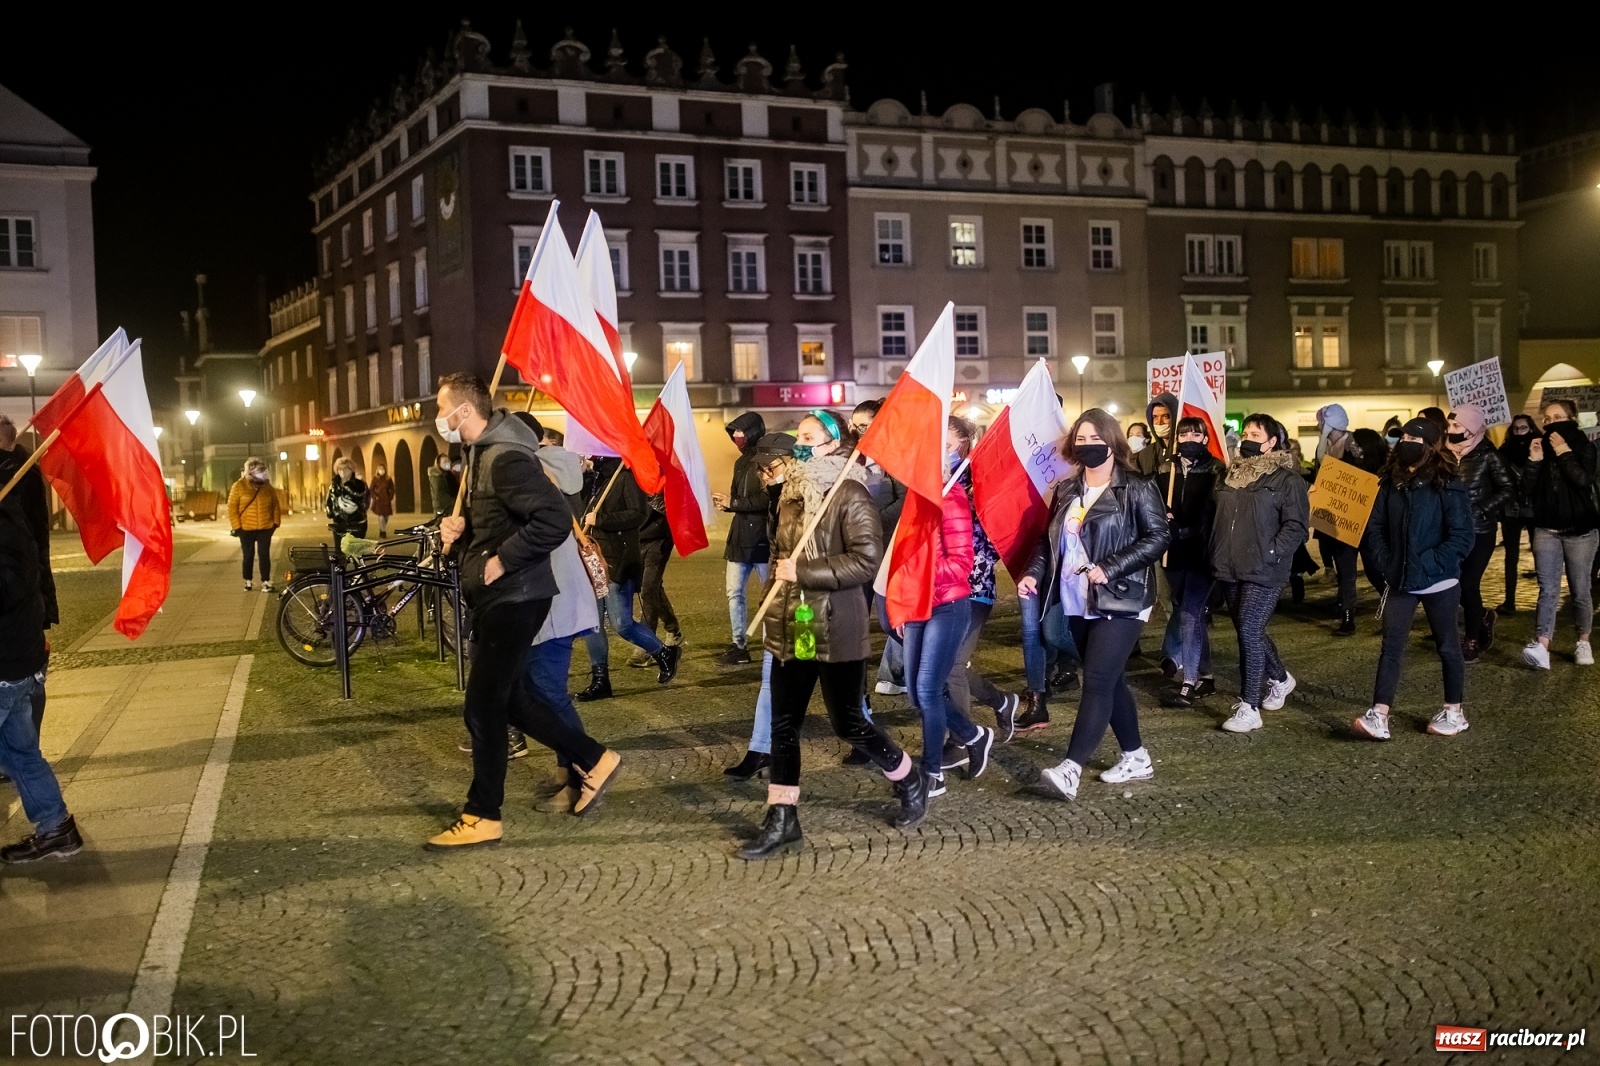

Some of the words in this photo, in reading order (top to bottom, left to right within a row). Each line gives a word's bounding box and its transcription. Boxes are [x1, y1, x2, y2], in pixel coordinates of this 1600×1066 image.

[1203, 360, 1222, 373] DO
[1447, 368, 1473, 385] WITAMY
[1449, 386, 1459, 397] TU
[1486, 372, 1500, 385] JEST
[1451, 396, 1465, 408] JAK
[1336, 470, 1359, 487] JAREK
[1327, 497, 1349, 513] JAJKO
